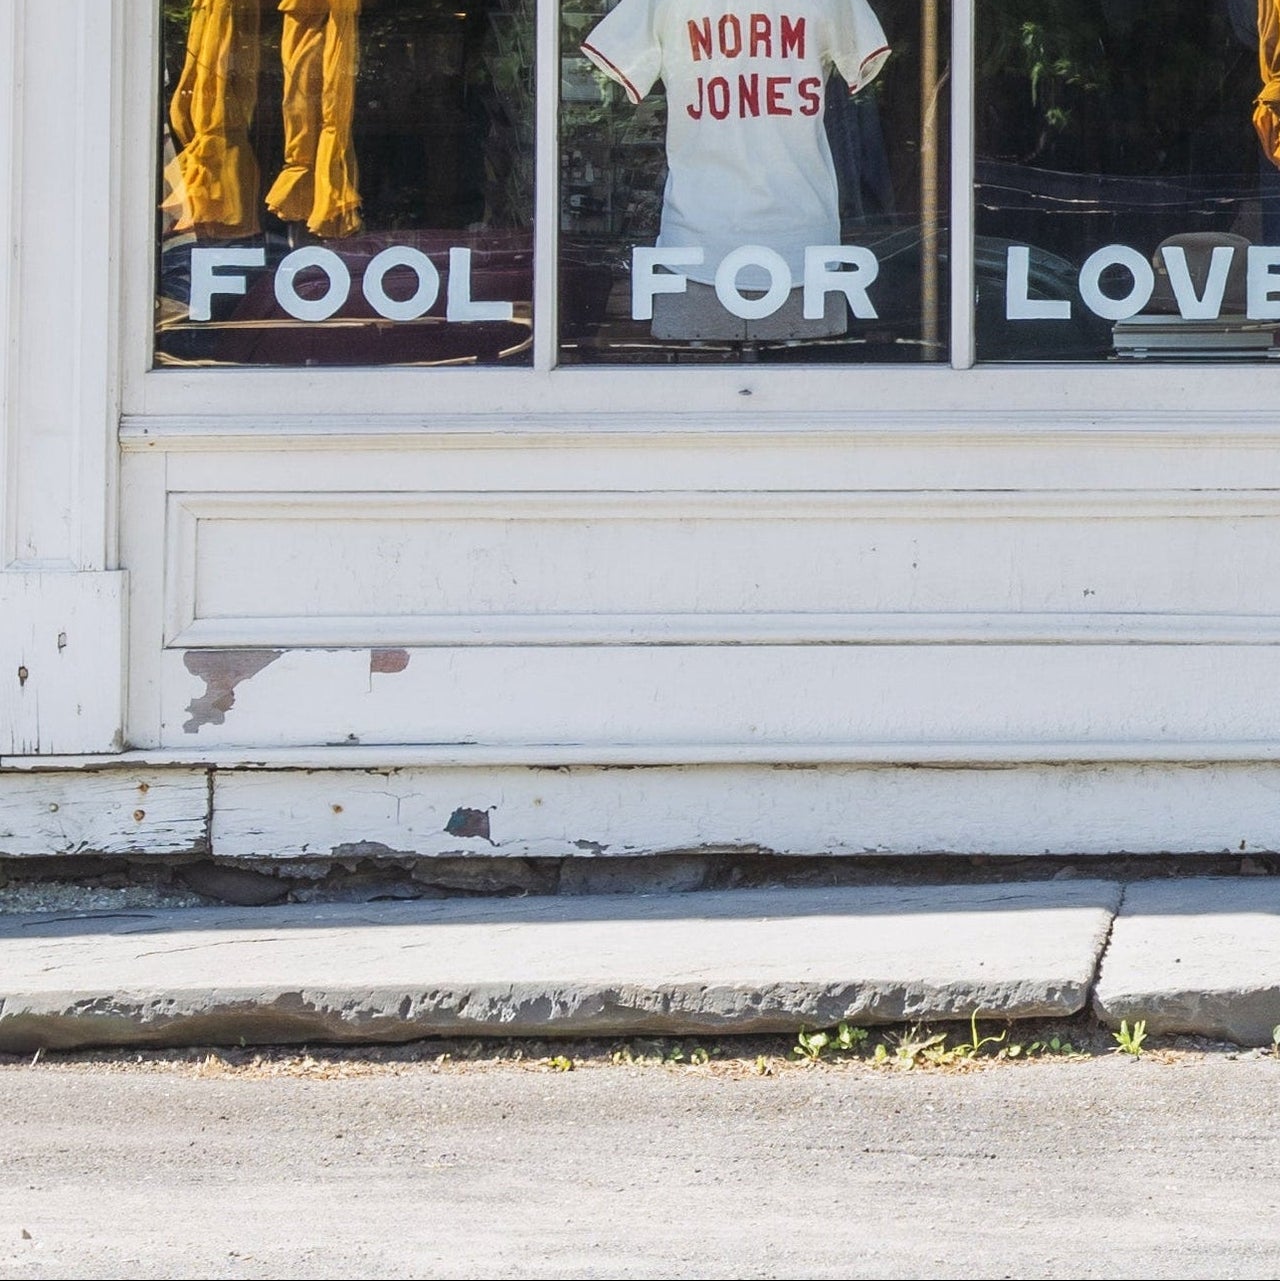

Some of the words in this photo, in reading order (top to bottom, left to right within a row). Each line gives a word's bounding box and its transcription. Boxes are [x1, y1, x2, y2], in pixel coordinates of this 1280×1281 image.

[687, 14, 806, 64] NORM
[687, 73, 822, 121] JONES
[189, 245, 513, 323] FOOL
[631, 244, 880, 321] FOR
